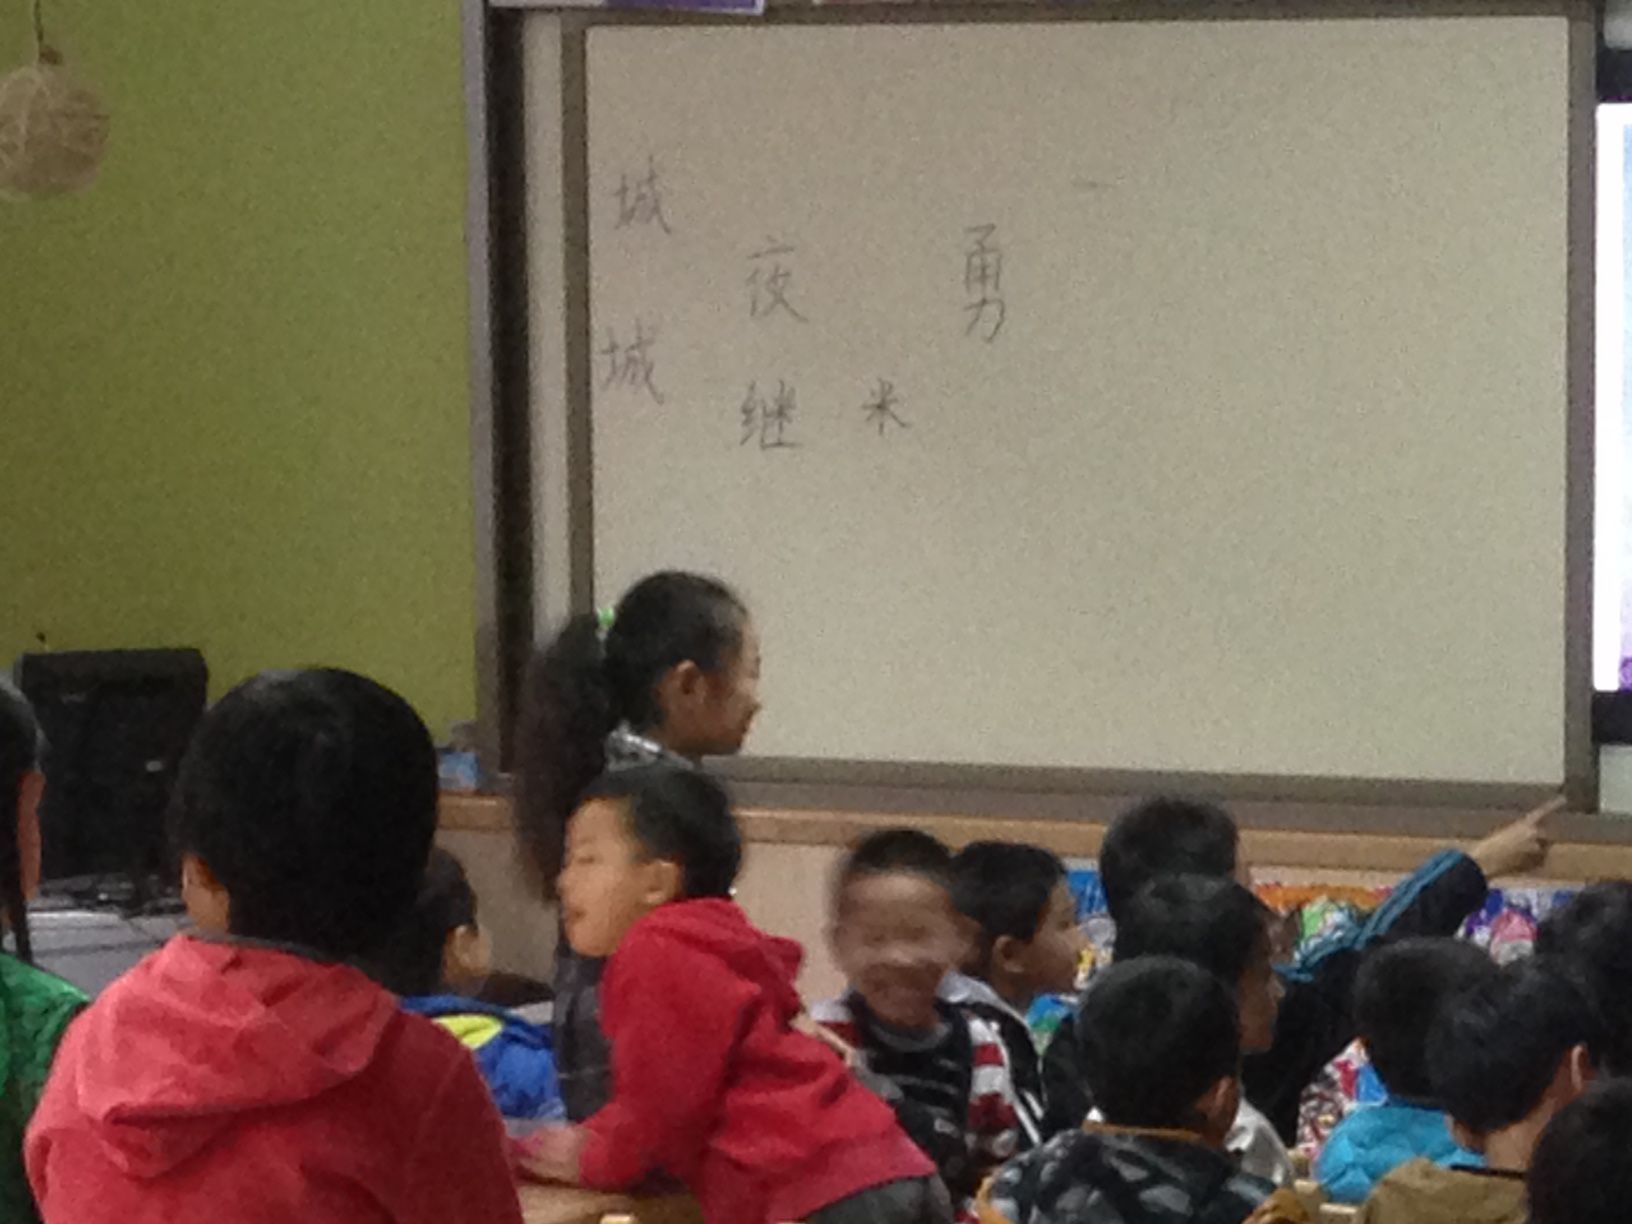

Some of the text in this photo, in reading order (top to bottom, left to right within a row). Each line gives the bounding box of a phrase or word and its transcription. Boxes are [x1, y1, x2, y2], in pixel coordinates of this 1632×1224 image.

[744, 233, 809, 323] 夜
[960, 221, 1007, 344] 勇
[737, 377, 802, 450] 继
